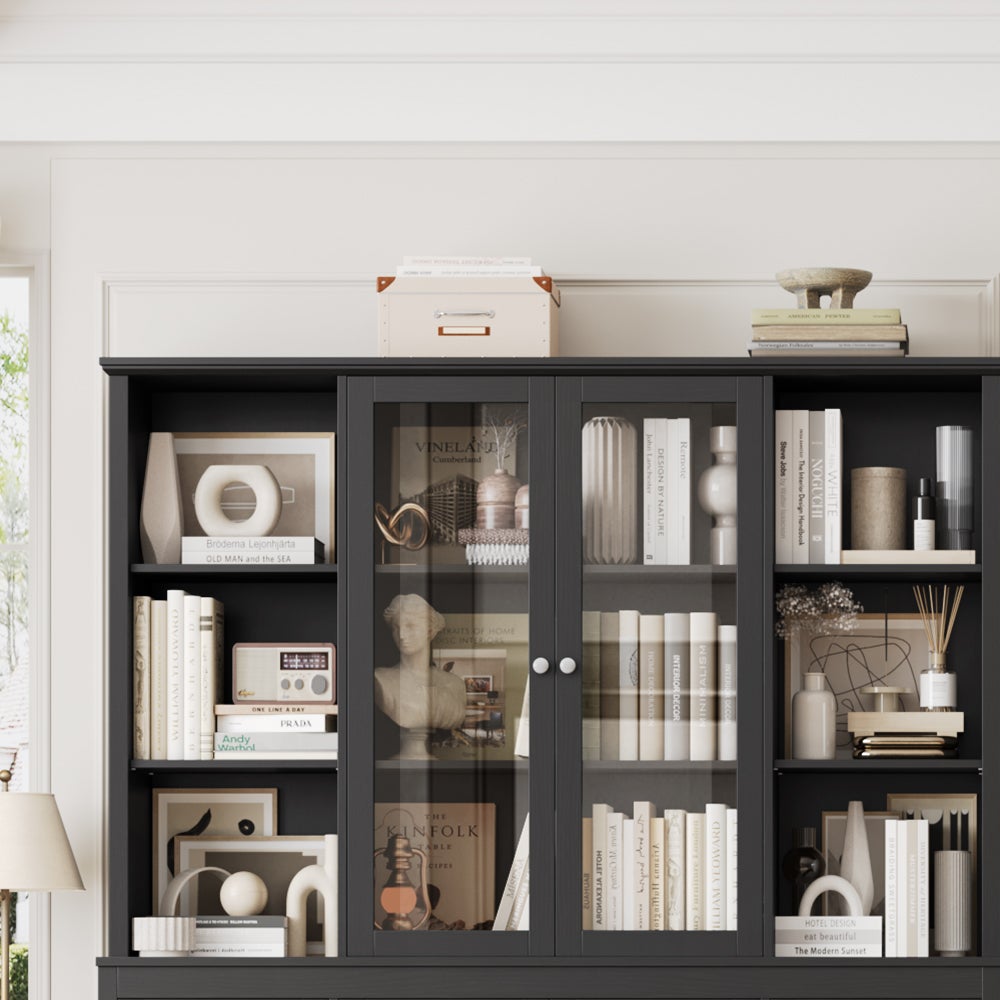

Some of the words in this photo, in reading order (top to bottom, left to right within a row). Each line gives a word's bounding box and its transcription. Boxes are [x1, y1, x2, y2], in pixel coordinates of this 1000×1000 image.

[432, 456, 482, 464] Cumberland
[780, 441, 788, 460] Steve
[680, 441, 688, 480] Remote
[780, 460, 788, 476] Jobs
[658, 486, 664, 497] BY
[812, 459, 823, 518] NOGUCHI
[827, 470, 838, 517] WHITE
[797, 494, 805, 514] Design
[672, 654, 680, 692] INTERIOR
[699, 644, 708, 728] MINIMALISM
[171, 683, 180, 741] WILLIAM
[672, 694, 680, 722] DECOR
[280, 720, 312, 728] PRADA
[222, 734, 250, 744] Andy
[387, 824, 480, 838] KINFOLK
[711, 888, 721, 929] ILLIAM
[804, 933, 817, 941] eat
[819, 932, 856, 941] beautiful
[795, 947, 808, 955] The
[810, 947, 840, 955] Modern
[841, 947, 867, 955] Sunset
